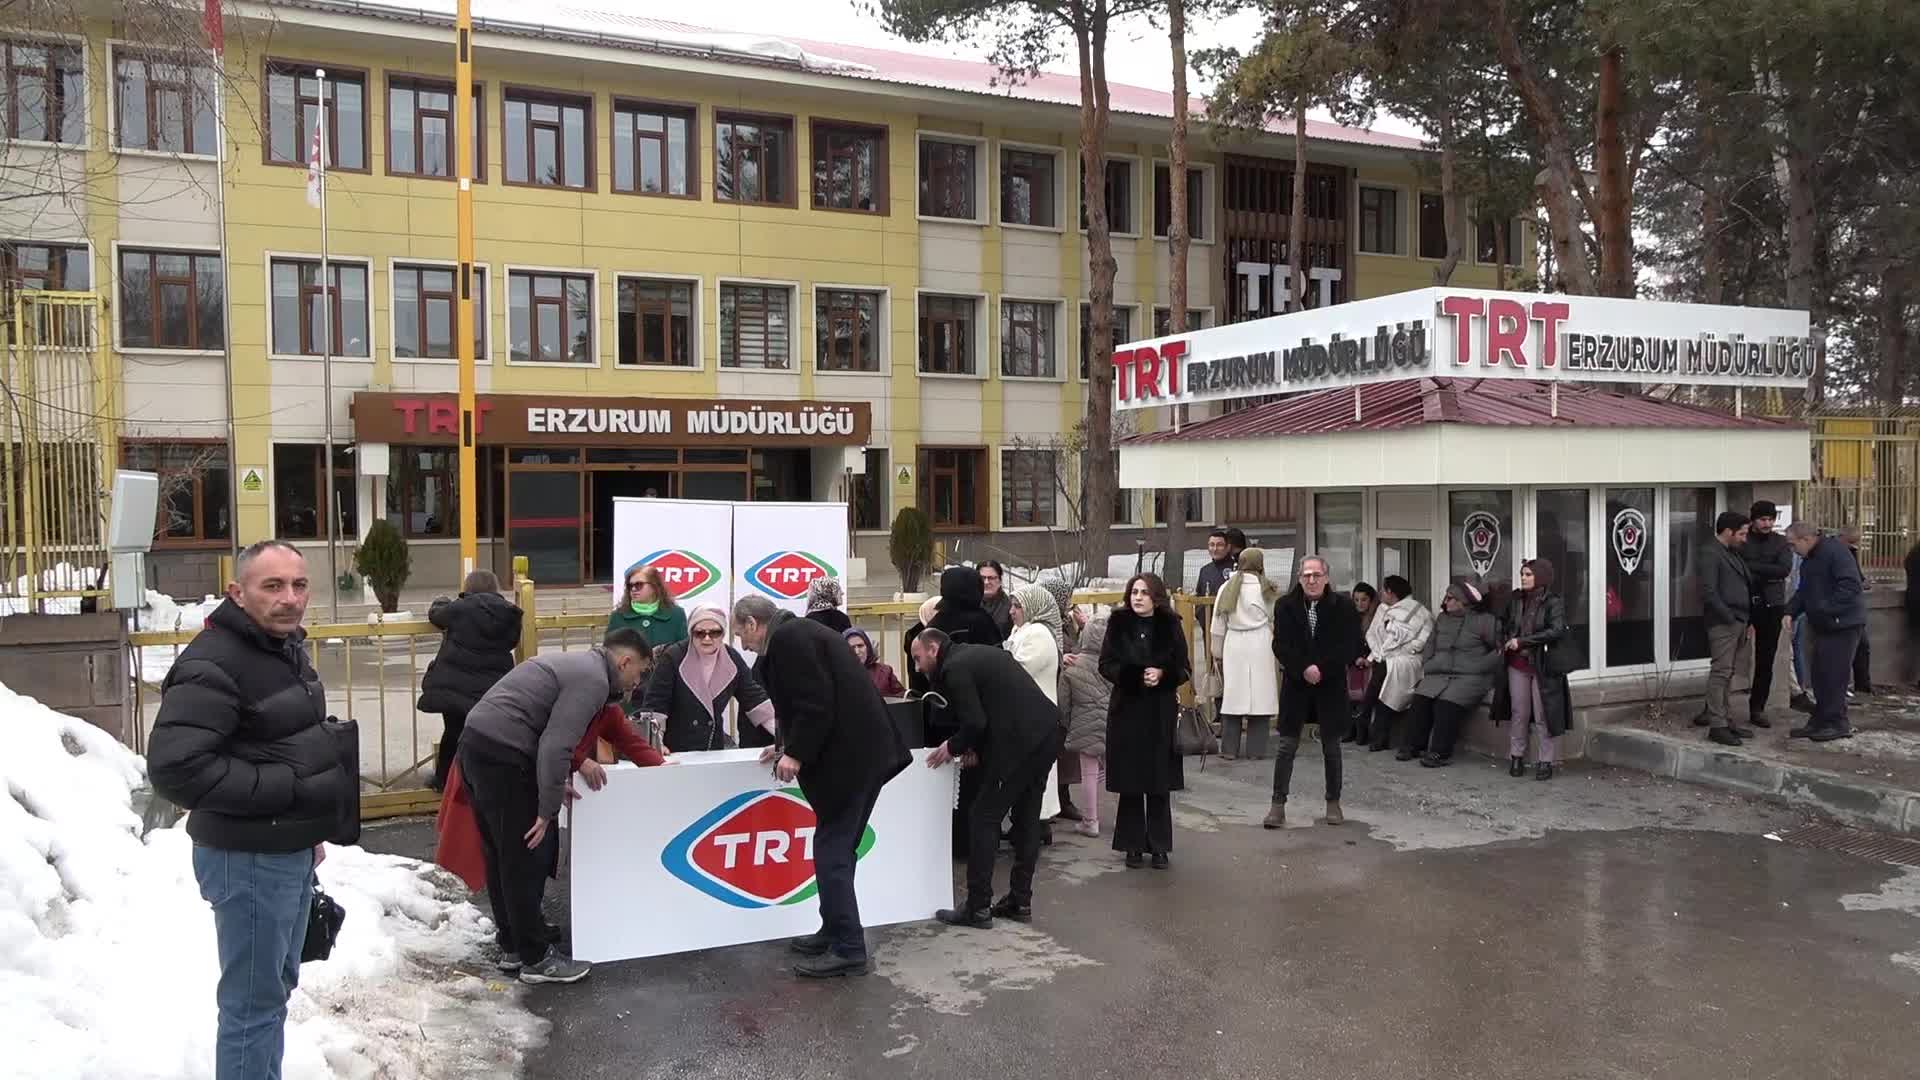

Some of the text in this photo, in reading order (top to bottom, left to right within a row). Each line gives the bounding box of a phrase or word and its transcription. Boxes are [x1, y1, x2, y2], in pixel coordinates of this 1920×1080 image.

[1236, 261, 1342, 312] TRT
[1441, 296, 1816, 377] TRT ERZURUM MÜDÜRLÜĞÜ
[1111, 340, 1189, 400] TRT
[1187, 350, 1275, 394] ERZURUM
[392, 399, 854, 435] TRT ERZURUM MÜDÜRLÜĞÜ
[765, 567, 817, 583] TRT
[713, 826, 817, 869] TRT
